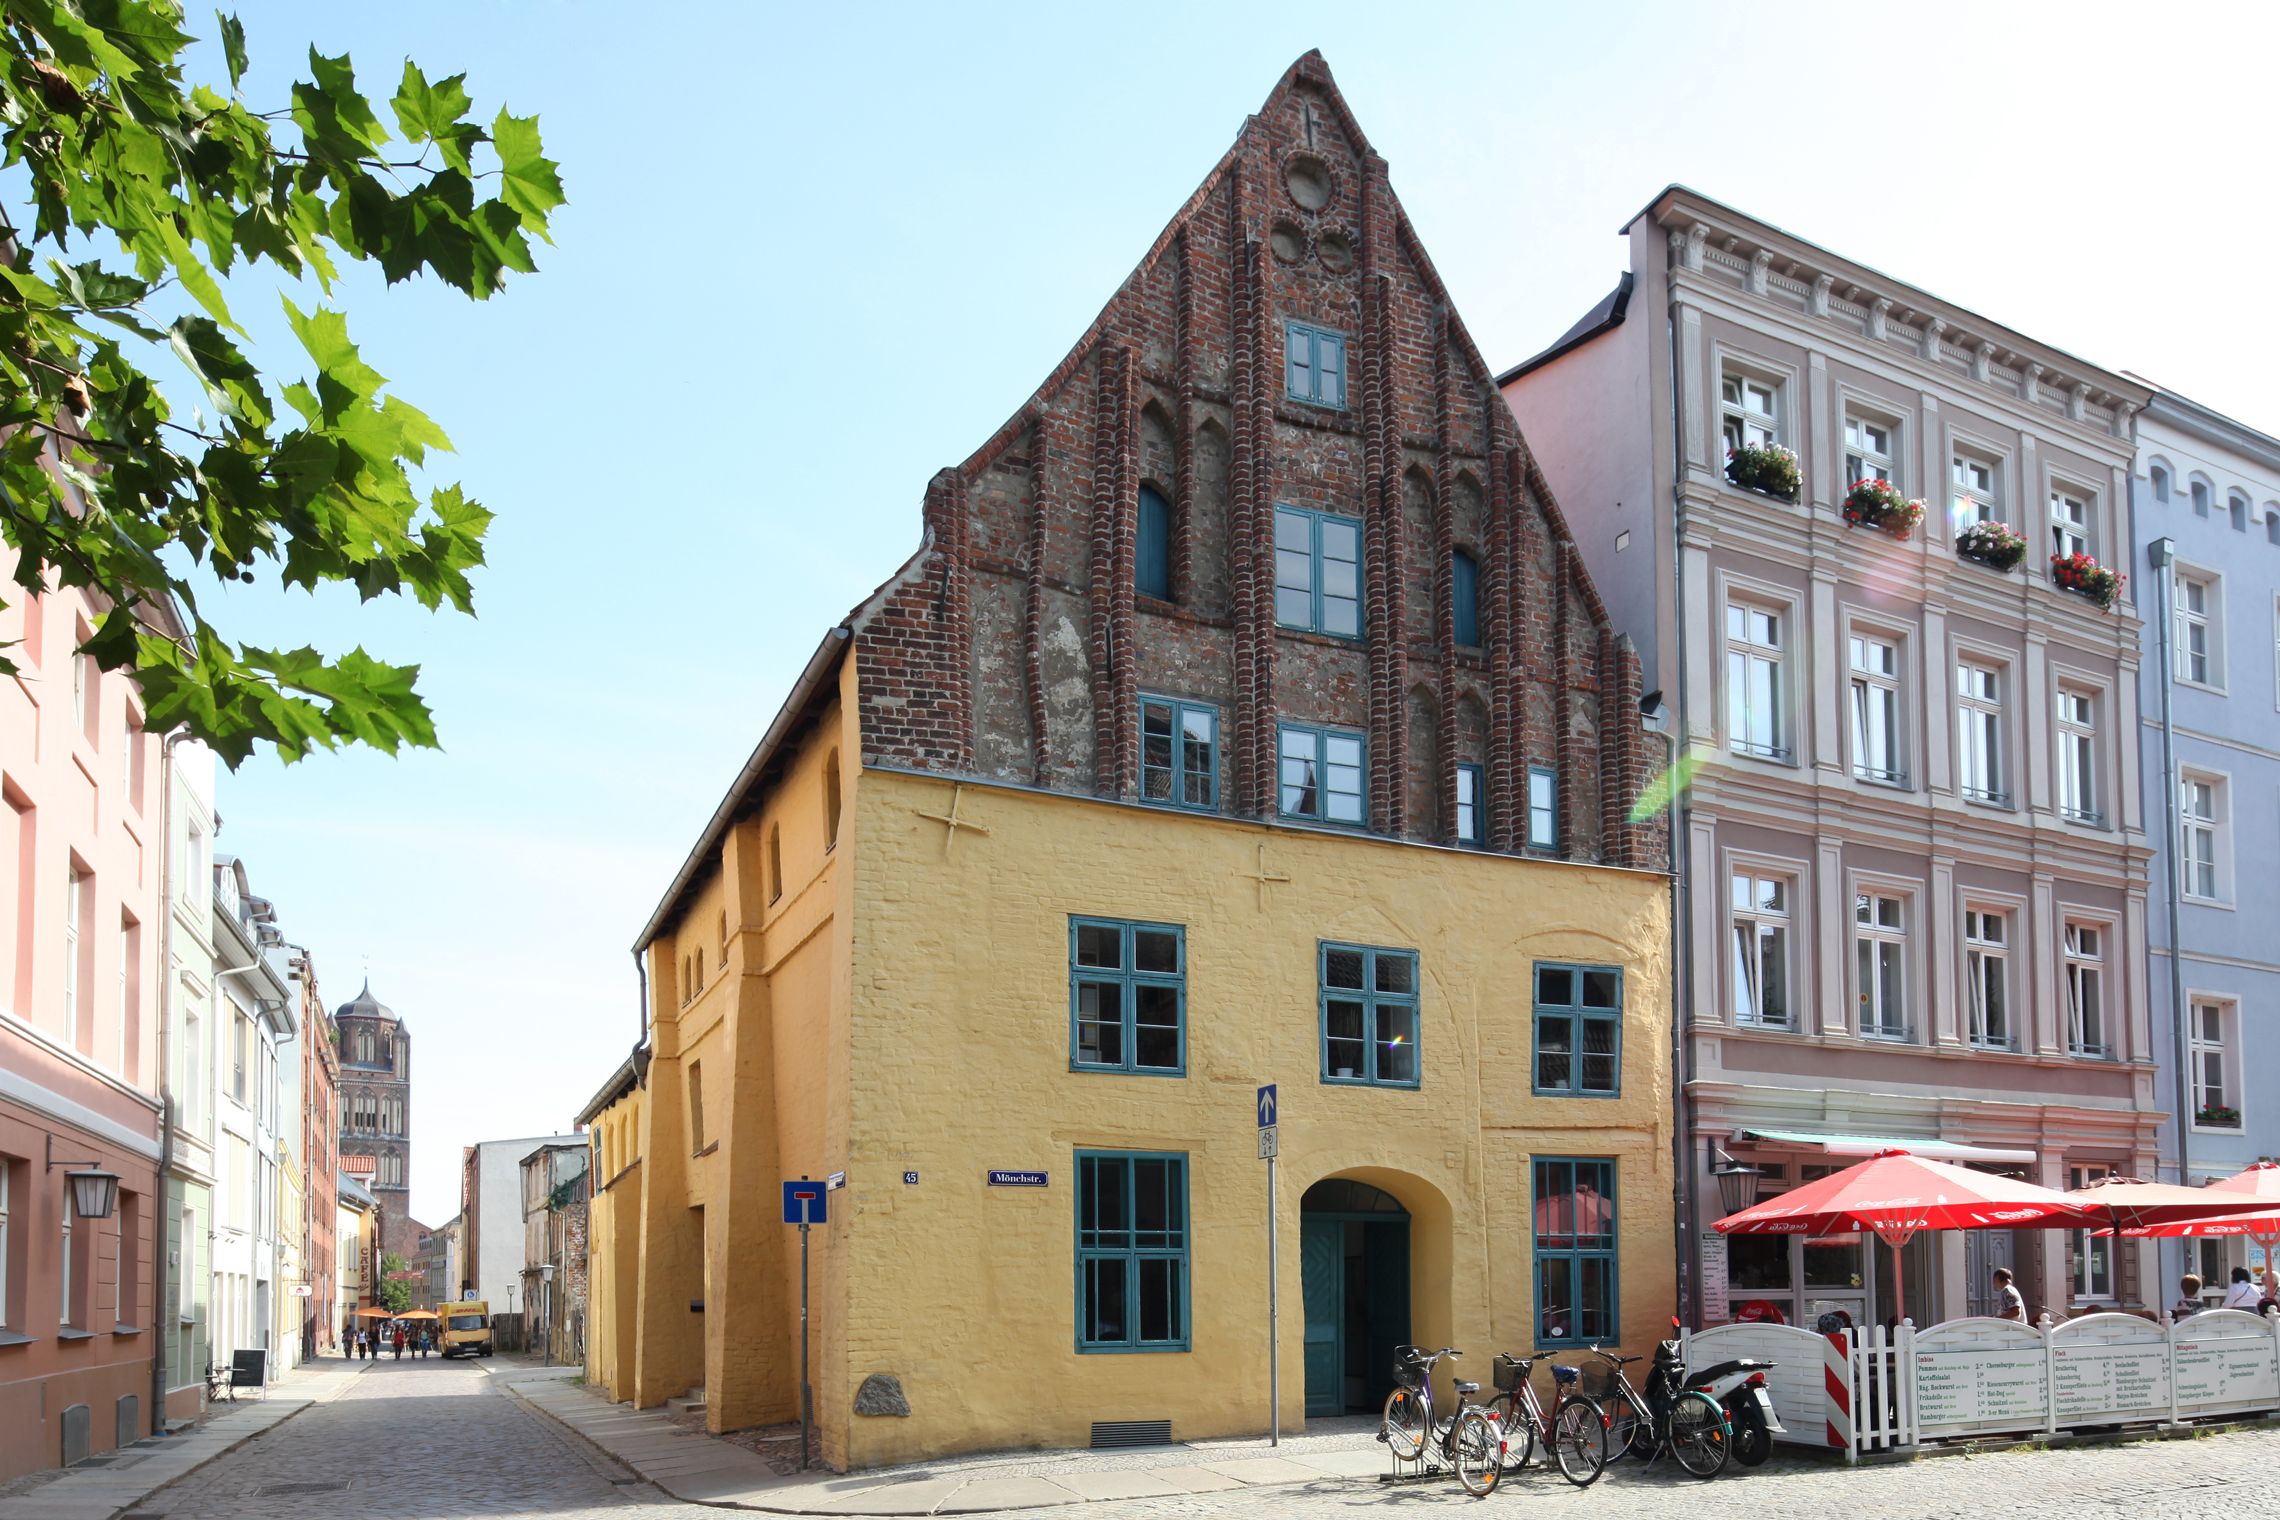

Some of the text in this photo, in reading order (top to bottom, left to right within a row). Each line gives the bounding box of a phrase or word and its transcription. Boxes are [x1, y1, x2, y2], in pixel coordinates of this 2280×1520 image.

[905, 1173, 916, 1183] 45
[995, 1173, 1042, 1184] Mönchstr.
[1918, 1374, 1951, 1382] Kartoffelsalat
[1920, 1413, 1946, 1422] Hamburger
